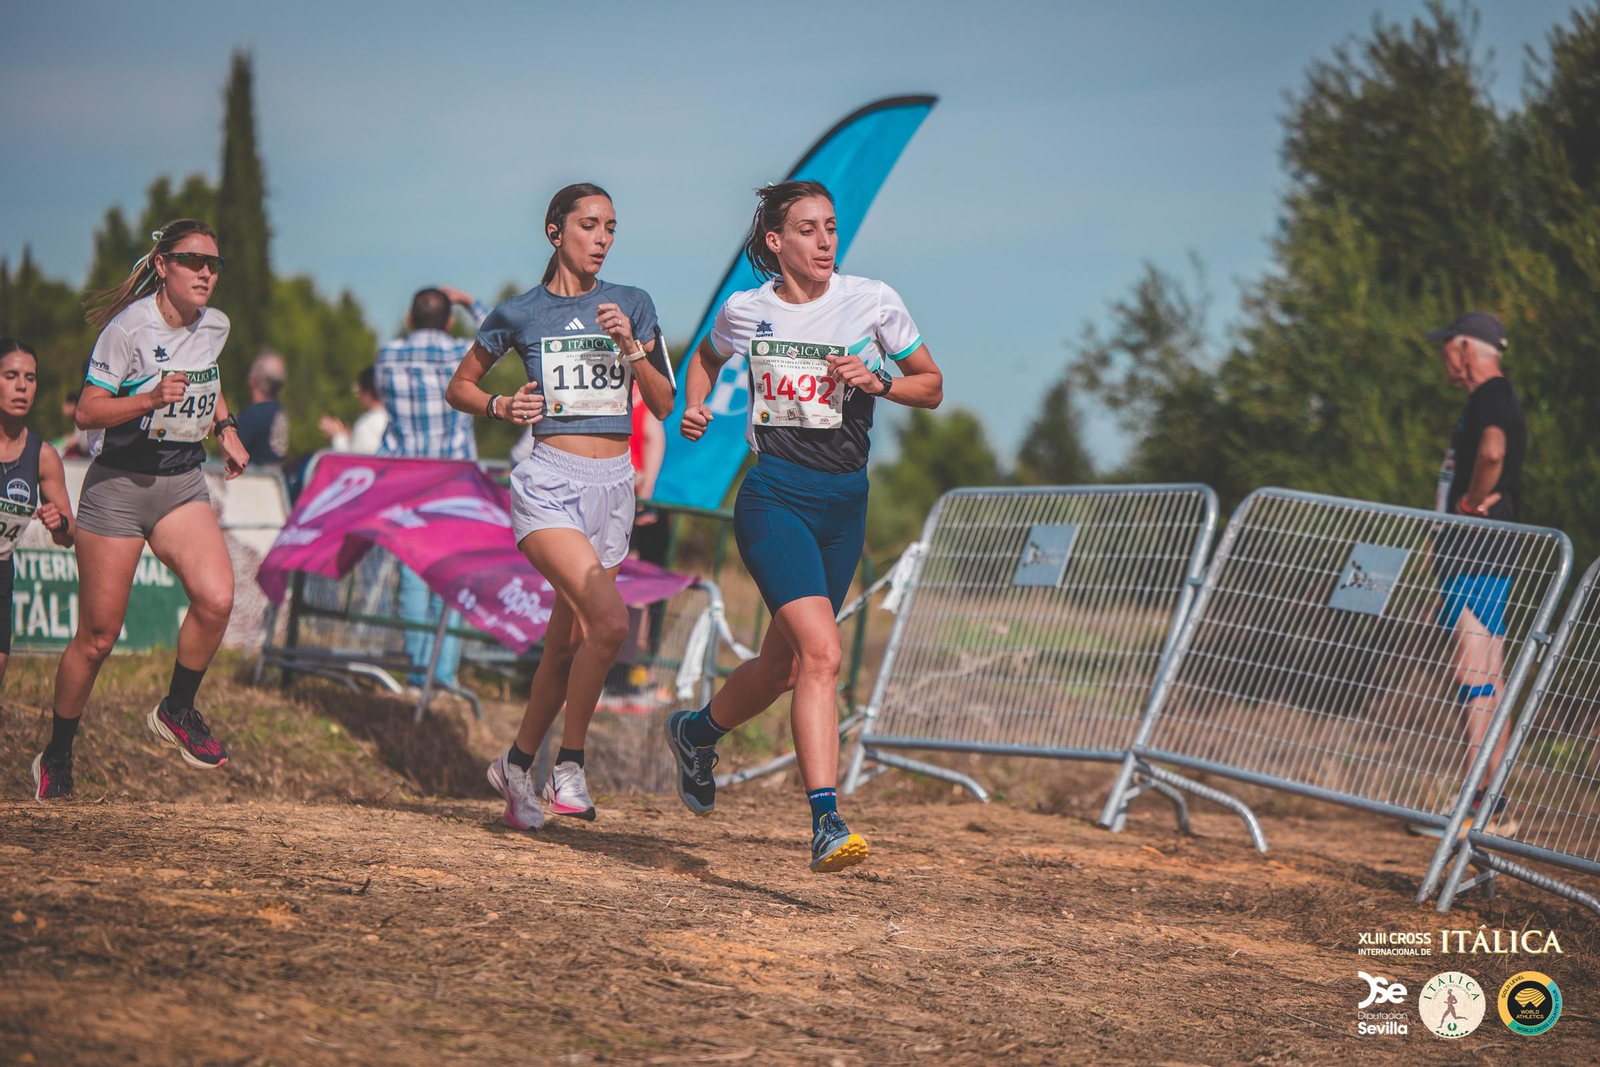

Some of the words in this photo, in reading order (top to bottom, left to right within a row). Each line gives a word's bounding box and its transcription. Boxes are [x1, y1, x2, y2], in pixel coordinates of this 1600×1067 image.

[568, 338, 609, 350] ITÁLICA
[186, 371, 210, 382] TÁLICA
[552, 364, 626, 391] 1189
[761, 372, 838, 406] 1492
